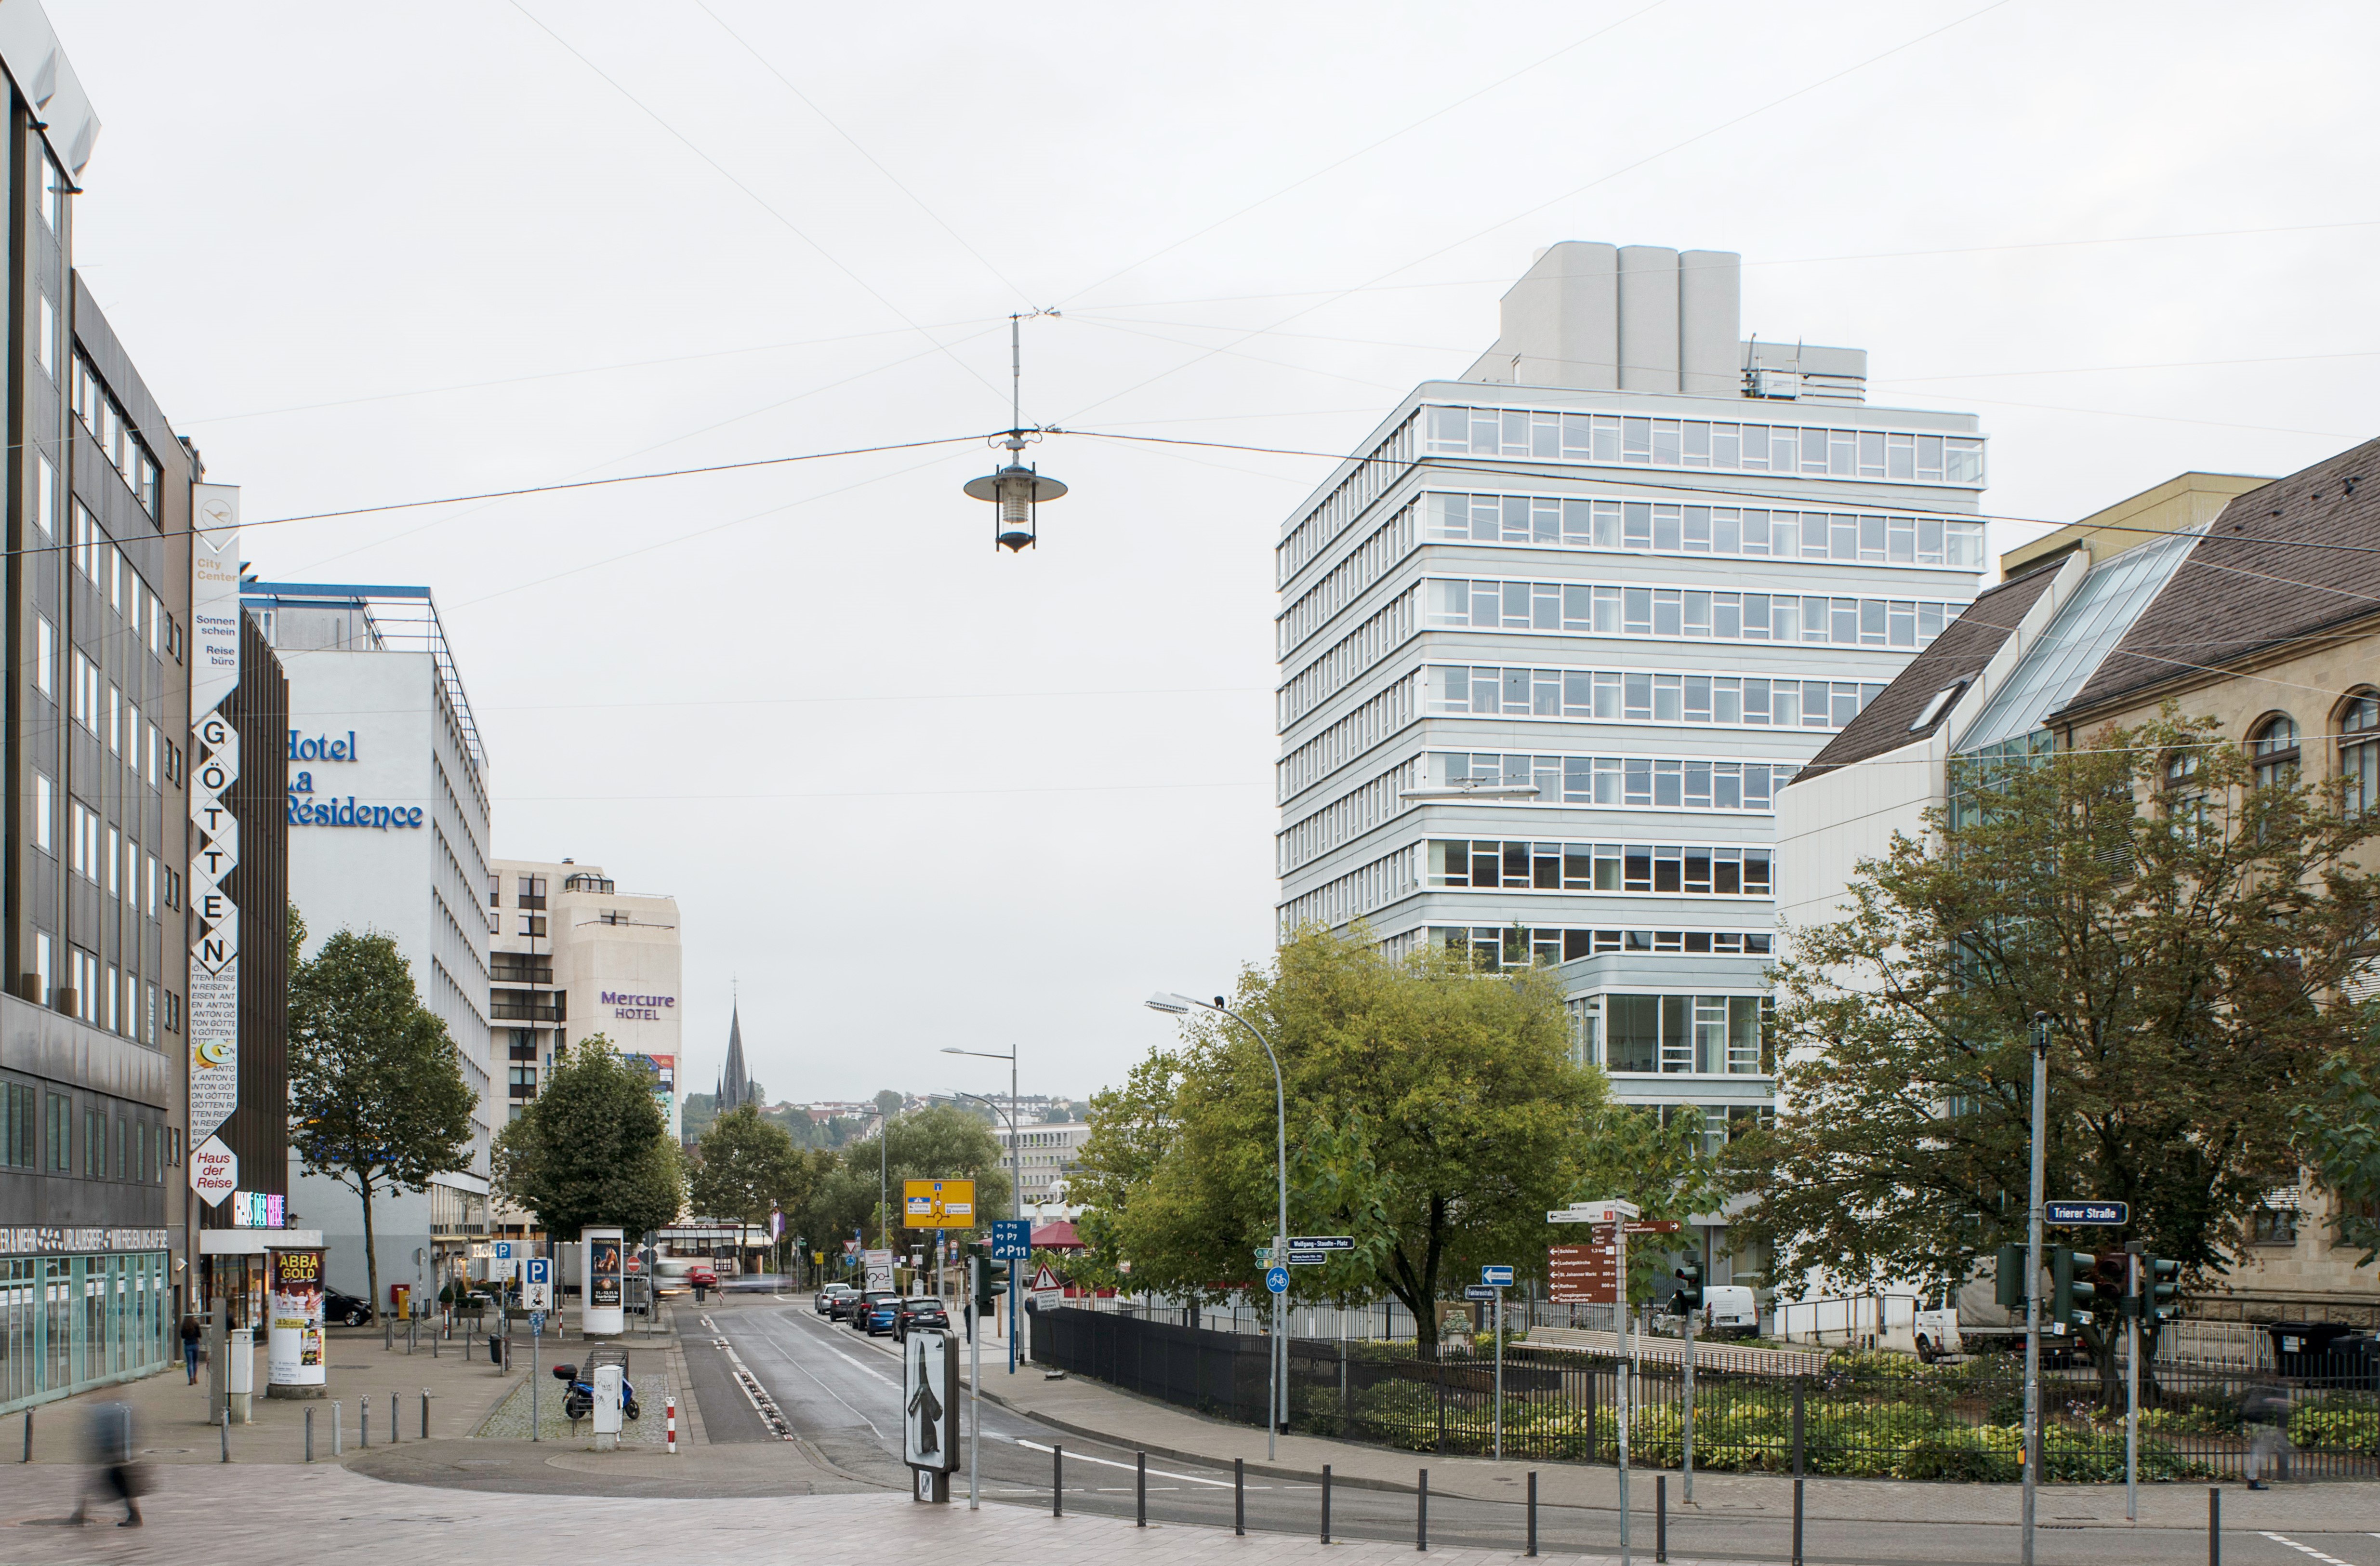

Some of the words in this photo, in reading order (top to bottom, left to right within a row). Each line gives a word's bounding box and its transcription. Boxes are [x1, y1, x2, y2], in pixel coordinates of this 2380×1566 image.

[198, 558, 221, 571] City
[197, 570, 237, 582] Center
[196, 615, 235, 626] Sonnen
[201, 626, 235, 636] schein
[206, 645, 235, 655] Reise
[212, 656, 235, 666] büro
[203, 721, 225, 962] GÖTTEN
[602, 991, 674, 1008] Mercure
[616, 1008, 660, 1020] HOTEL
[198, 1028, 231, 1036] GÖTTEN
[197, 1153, 230, 1163] Haus
[202, 1165, 225, 1176] der
[197, 1177, 232, 1188] Reise
[234, 1191, 253, 1226] HAUS
[254, 1193, 267, 1226] DER
[2054, 1208, 2084, 1218] Trierer
[2086, 1208, 2116, 1218] Straße
[10, 1228, 16, 1253] &
[16, 1228, 37, 1252] MEHR
[1007, 1233, 1018, 1241] P7
[500, 1245, 508, 1257] P
[1007, 1245, 1026, 1256] P11
[279, 1255, 318, 1268] ABBA
[282, 1268, 315, 1279] GOLD
[531, 1262, 543, 1281] P
